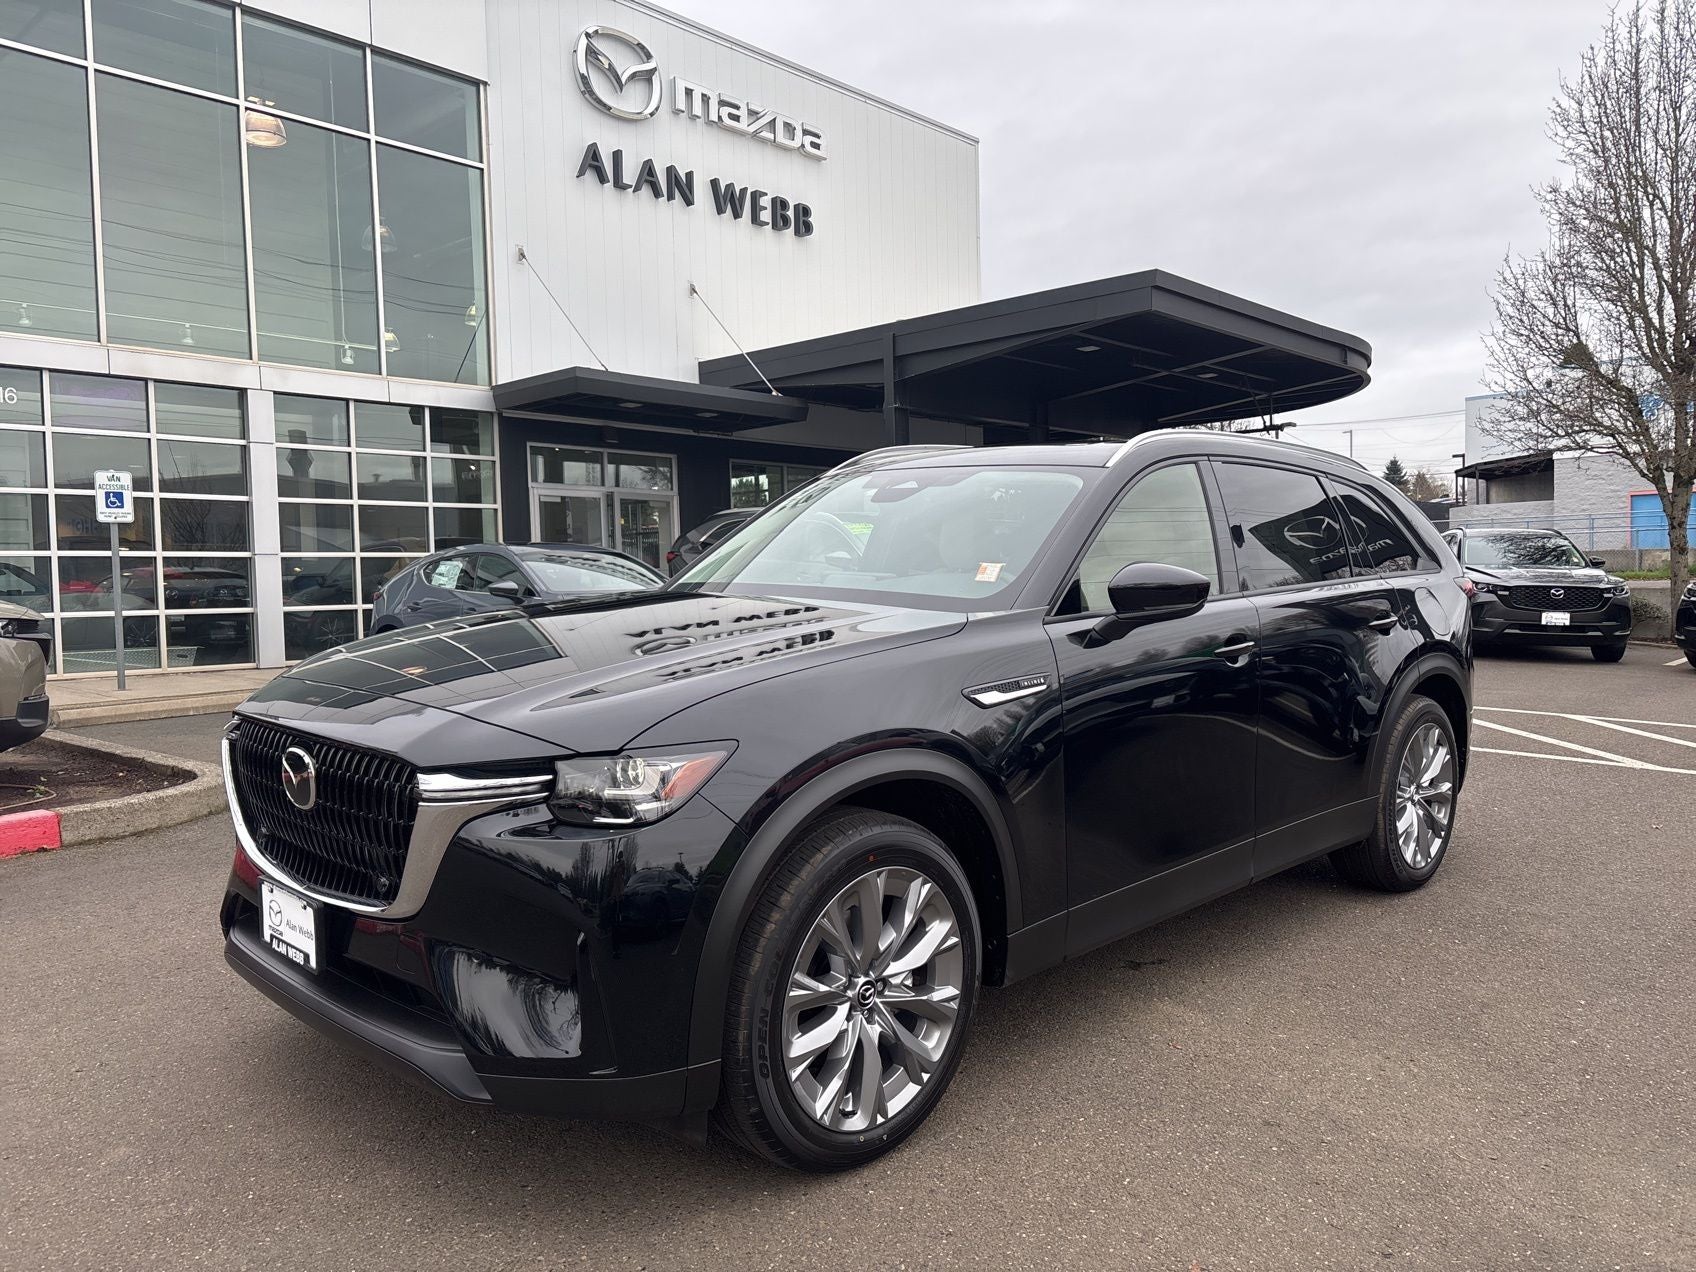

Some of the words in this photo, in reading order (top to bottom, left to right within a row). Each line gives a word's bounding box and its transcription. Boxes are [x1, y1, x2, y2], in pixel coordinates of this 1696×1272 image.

[576, 141, 695, 208] ALAN
[709, 177, 815, 238] WEBB
[98, 483, 130, 491] ACCESSIBLE
[106, 474, 121, 483] VAN
[286, 919, 297, 933] Alan
[298, 924, 314, 941] Webb
[271, 938, 287, 956] ALAN
[287, 945, 304, 965] WEBB
[758, 1008, 769, 1079] OPEN
